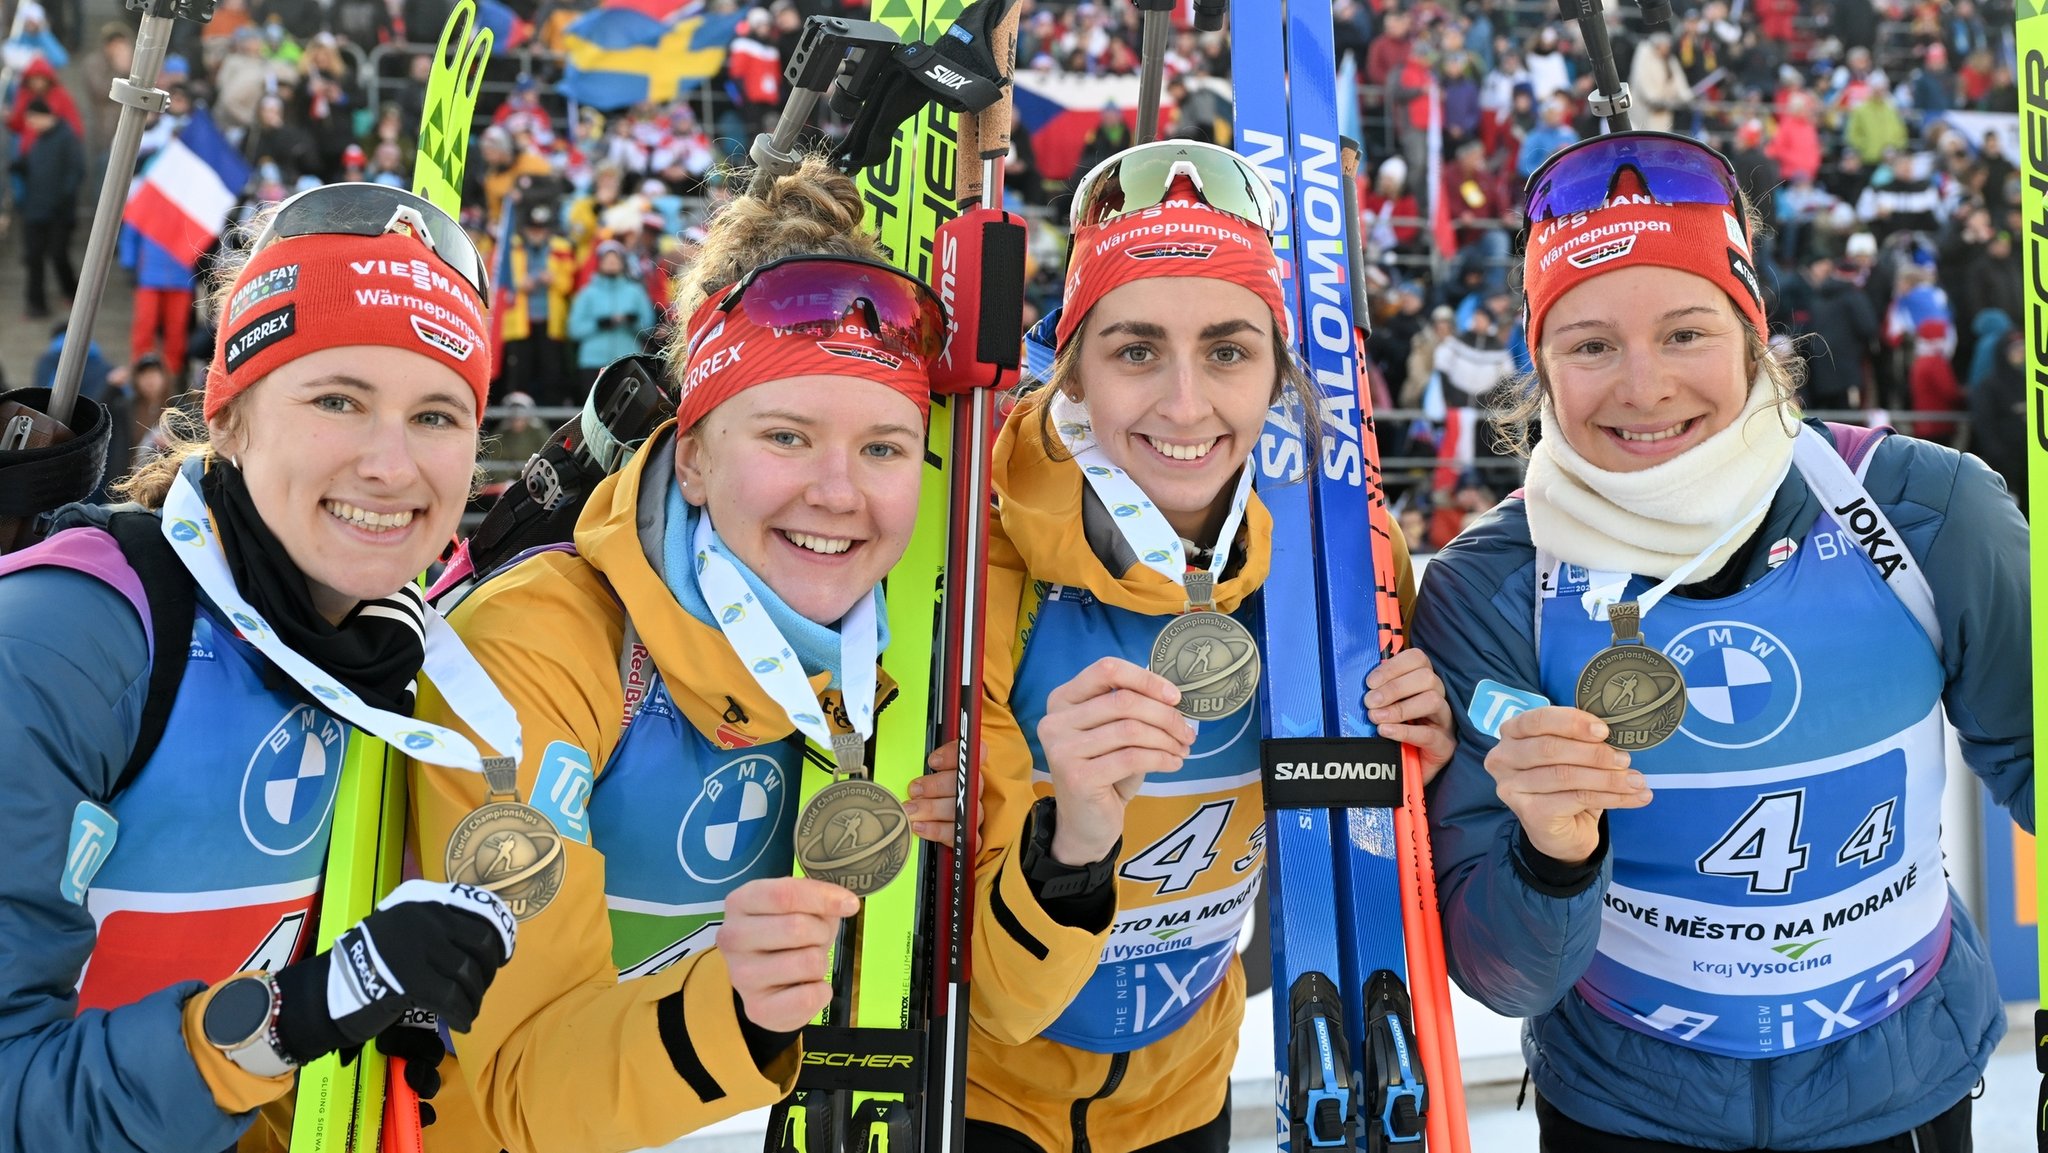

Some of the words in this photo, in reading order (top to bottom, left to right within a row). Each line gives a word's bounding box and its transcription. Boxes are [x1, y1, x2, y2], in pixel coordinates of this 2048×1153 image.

[925, 64, 973, 90] SWIX
[1095, 222, 1252, 256] Wärmepumpen
[1539, 219, 1671, 272] Wärmepumpen
[355, 289, 487, 351] Wärmepumpen
[1300, 133, 1362, 488] SALOMON
[240, 312, 290, 352] TERREX
[681, 341, 745, 400] ERREX
[1814, 529, 1854, 561] BM
[1834, 497, 1904, 581] JOKA
[1184, 574, 1213, 583] 2024
[1575, 584, 1591, 592] 202
[1609, 604, 1639, 617] 2024
[1156, 636, 1172, 663] World
[1169, 617, 1232, 637] Championships
[1670, 628, 1777, 666] BMW
[628, 642, 650, 687] Red
[1581, 670, 1597, 694] World
[1596, 650, 1660, 671] Championships
[621, 687, 642, 728] Bull
[1192, 698, 1225, 713] IBU
[269, 709, 339, 755] BMW
[832, 735, 863, 748] 2024
[1616, 730, 1649, 745] IBU
[706, 761, 781, 803] BMW
[956, 708, 969, 816] SWIX
[1274, 762, 1396, 781] SALOMON
[801, 808, 819, 837] World
[817, 787, 884, 809] Championships
[453, 829, 471, 860] World
[469, 809, 538, 830] Championships
[1118, 798, 1237, 896] 4
[1696, 787, 1810, 895] 4
[1836, 796, 1898, 868] 4
[839, 874, 873, 890] IBU
[951, 823, 962, 966] AERODYNAMICS
[1665, 915, 1765, 941] MĚSTO
[1773, 919, 1814, 941] NA
[1822, 862, 1918, 932] MORAVĚ
[451, 883, 517, 942] ROECK
[1155, 910, 1191, 928] NA
[1115, 965, 1128, 999] NEW
[1692, 960, 1733, 979] Kraj
[1113, 1006, 1128, 1036] THE
[1758, 1005, 1771, 1034] NEW
[801, 1051, 914, 1069] ISCHER
[1317, 1021, 1332, 1071] SALOMON
[1391, 1019, 1408, 1067] SALOMON
[319, 1076, 328, 1115] GLIDING
